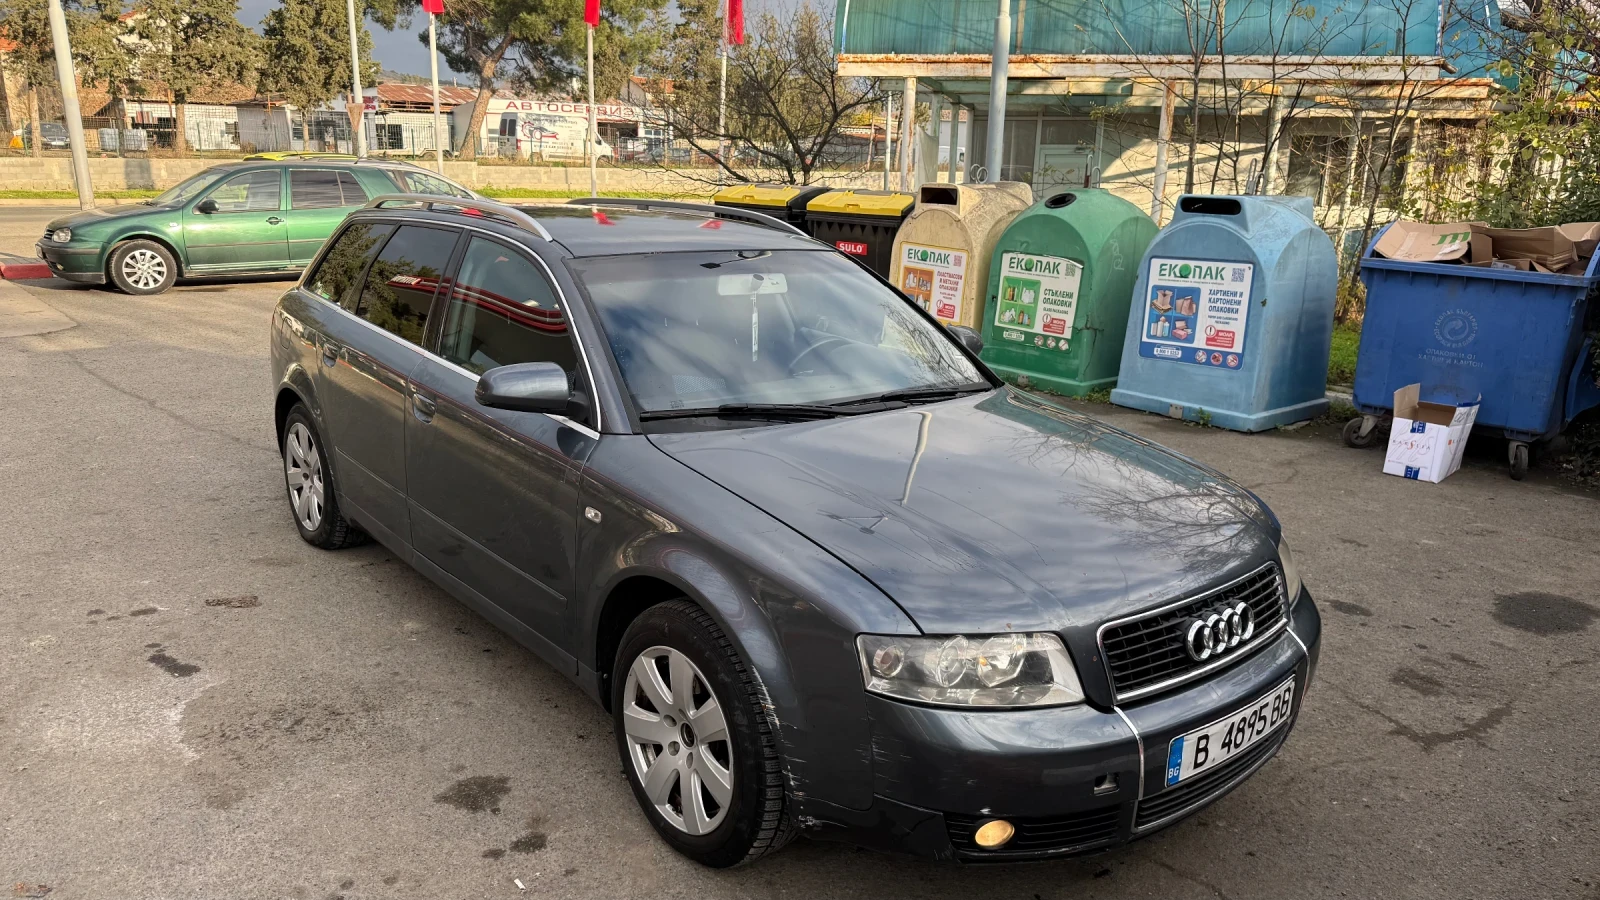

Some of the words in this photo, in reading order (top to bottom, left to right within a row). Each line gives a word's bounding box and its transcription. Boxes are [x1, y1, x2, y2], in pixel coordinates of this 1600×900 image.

[839, 243, 863, 253] SULO
[907, 248, 951, 265] ЕКОПАК
[1008, 257, 1062, 275] ЕКОПАК
[1158, 263, 1226, 281] ЕКОПАК
[1043, 288, 1074, 299] СТЪКЛЕНИ
[1208, 288, 1238, 298] ХАРТИЕНИ
[1042, 297, 1073, 308] ОПАКОВКИ
[1207, 298, 1242, 307] КАРТОНЕНИ
[1208, 305, 1239, 315] ОПАКОВКИ
[1193, 733, 1210, 770] B
[1221, 701, 1269, 755] 4895
[1269, 686, 1292, 728] BB
[1168, 766, 1180, 779] BG
